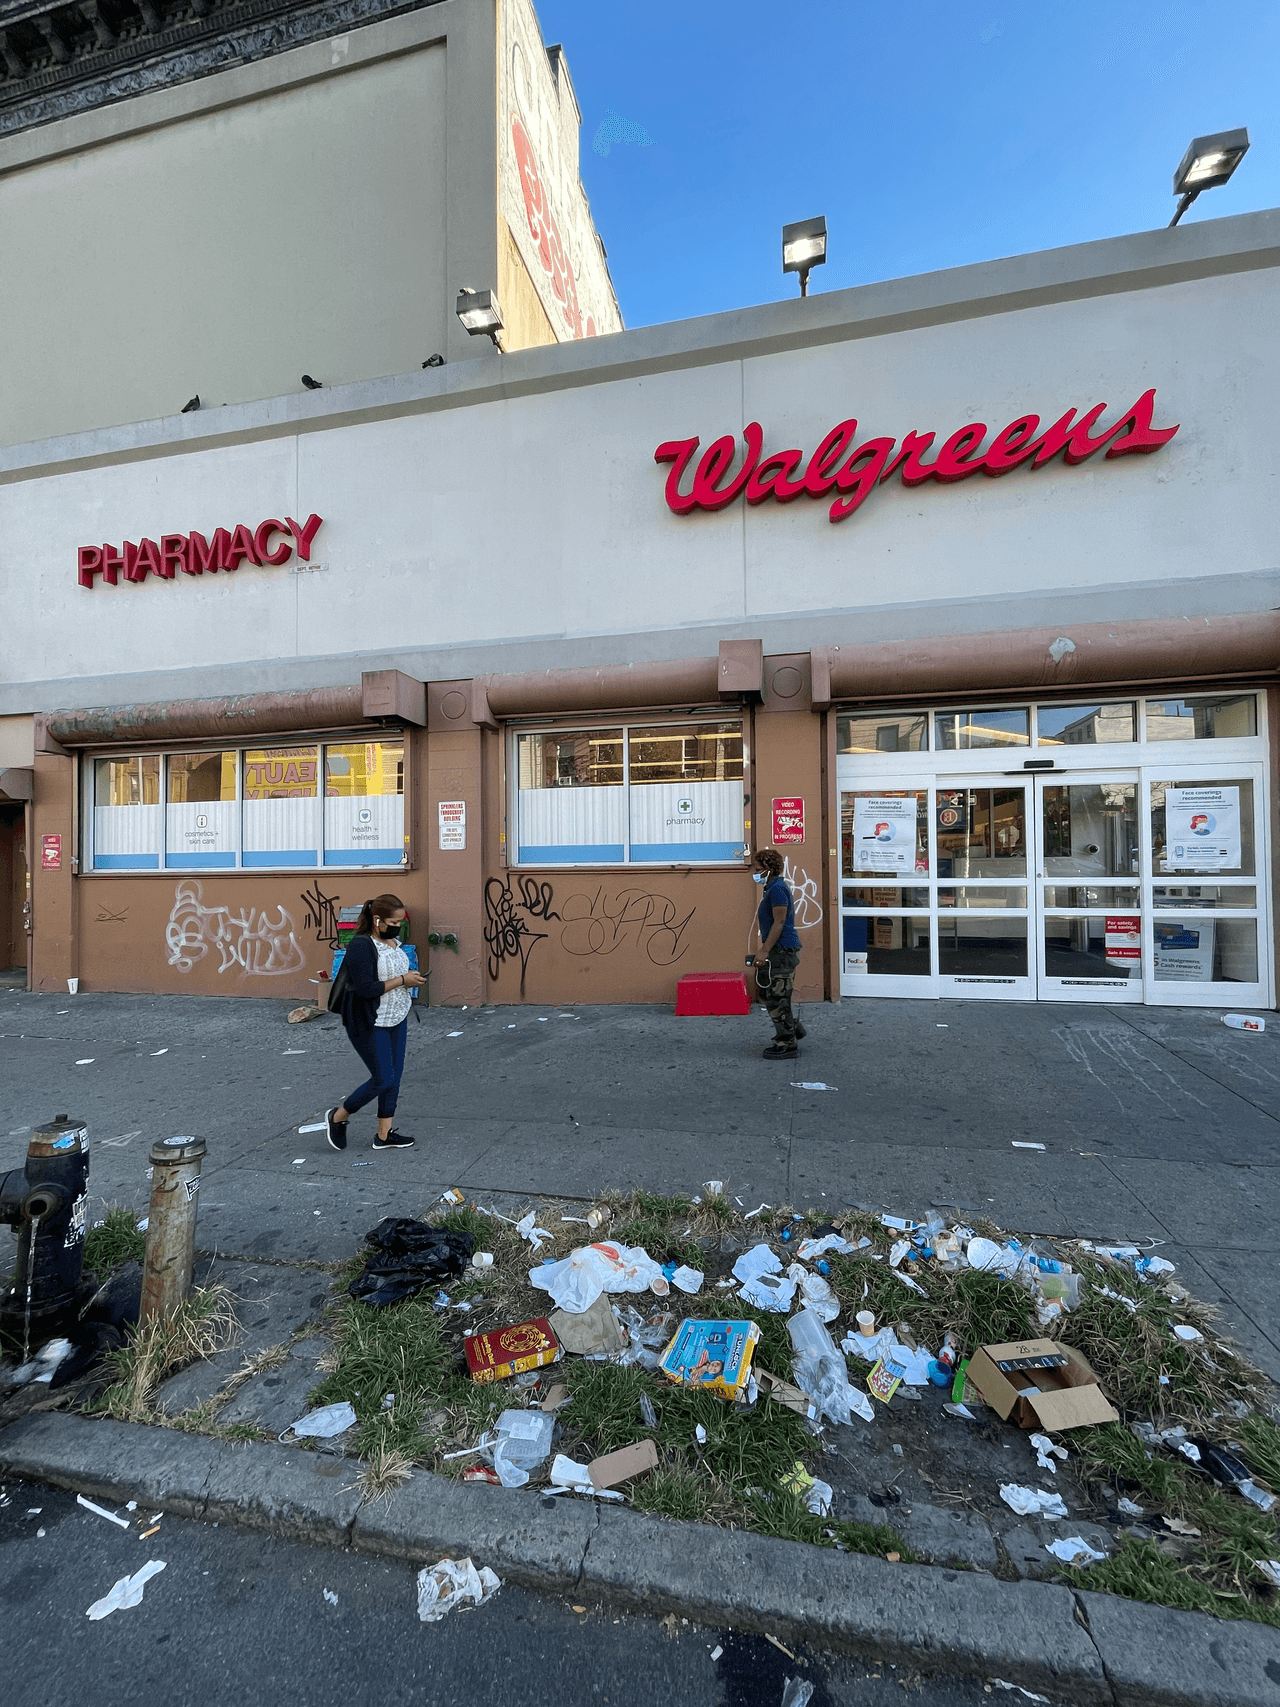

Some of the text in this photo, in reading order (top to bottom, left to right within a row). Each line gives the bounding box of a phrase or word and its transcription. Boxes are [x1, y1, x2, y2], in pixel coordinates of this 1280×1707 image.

[654, 388, 1180, 524] Walgreens
[78, 513, 323, 589] PHARMACY
[352, 825, 372, 833] health
[666, 817, 706, 827] pharmacy
